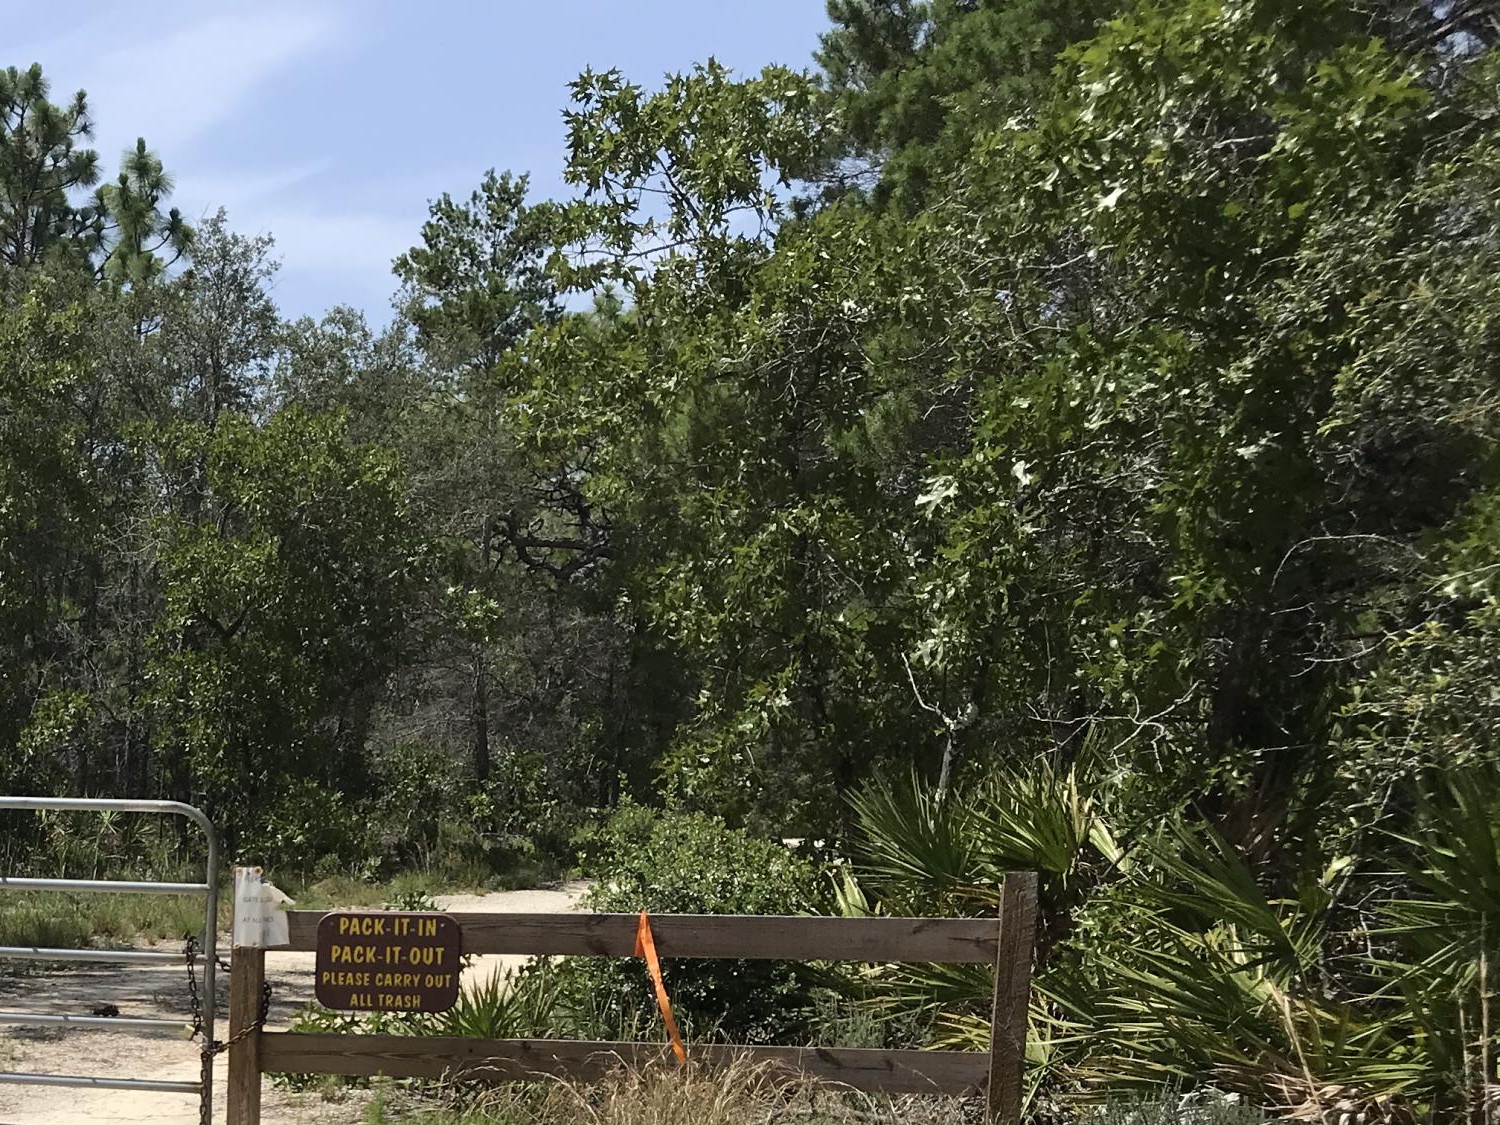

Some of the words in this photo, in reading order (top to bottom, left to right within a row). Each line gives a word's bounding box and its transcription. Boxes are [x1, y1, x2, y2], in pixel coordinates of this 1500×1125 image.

[339, 917, 437, 937] PACK-IT-IN
[331, 945, 445, 966] PACK-IT-OUT
[322, 971, 370, 986] PLEASE
[375, 973, 421, 987] CARRY
[424, 974, 451, 988] OUT
[350, 994, 373, 1007] ALL
[378, 994, 421, 1008] TRASH
